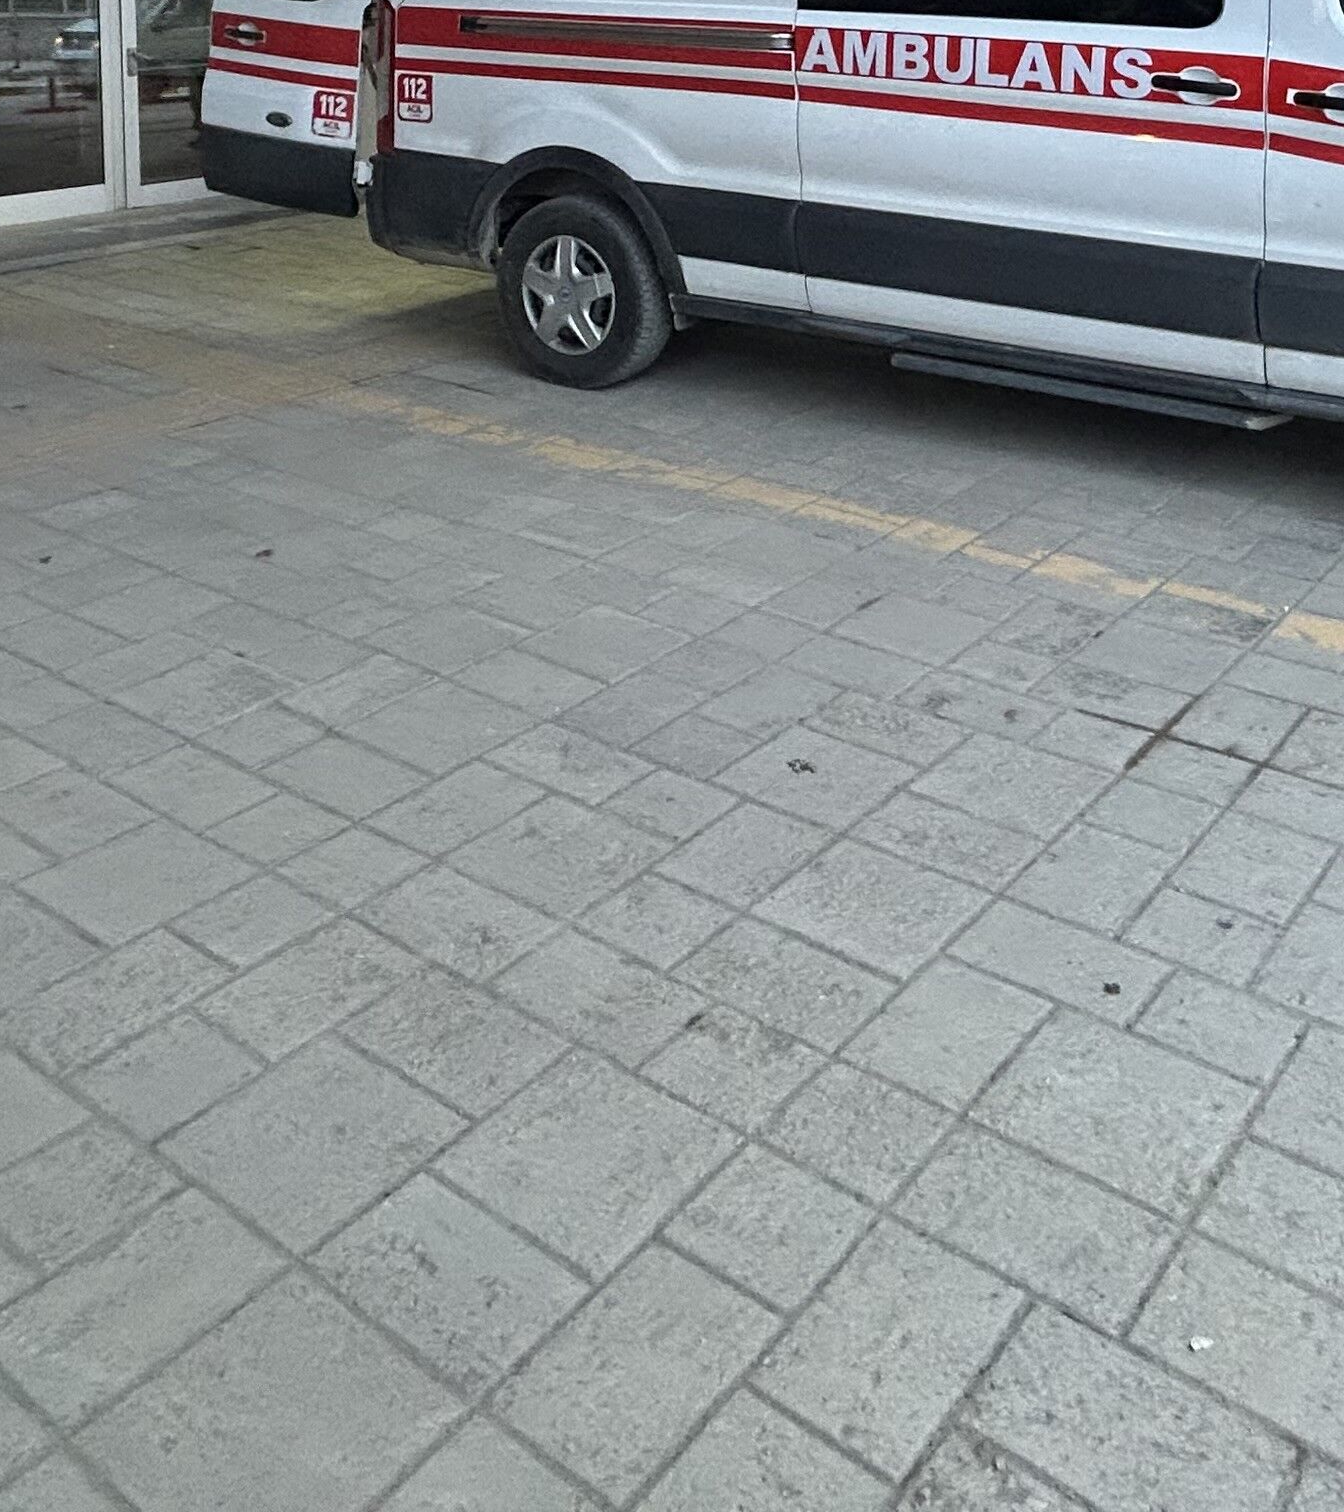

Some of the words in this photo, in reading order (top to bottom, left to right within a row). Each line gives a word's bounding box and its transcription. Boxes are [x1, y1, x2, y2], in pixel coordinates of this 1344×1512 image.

[800, 27, 1155, 100] AMBULANS
[402, 76, 428, 100] 112
[319, 94, 349, 118] 112
